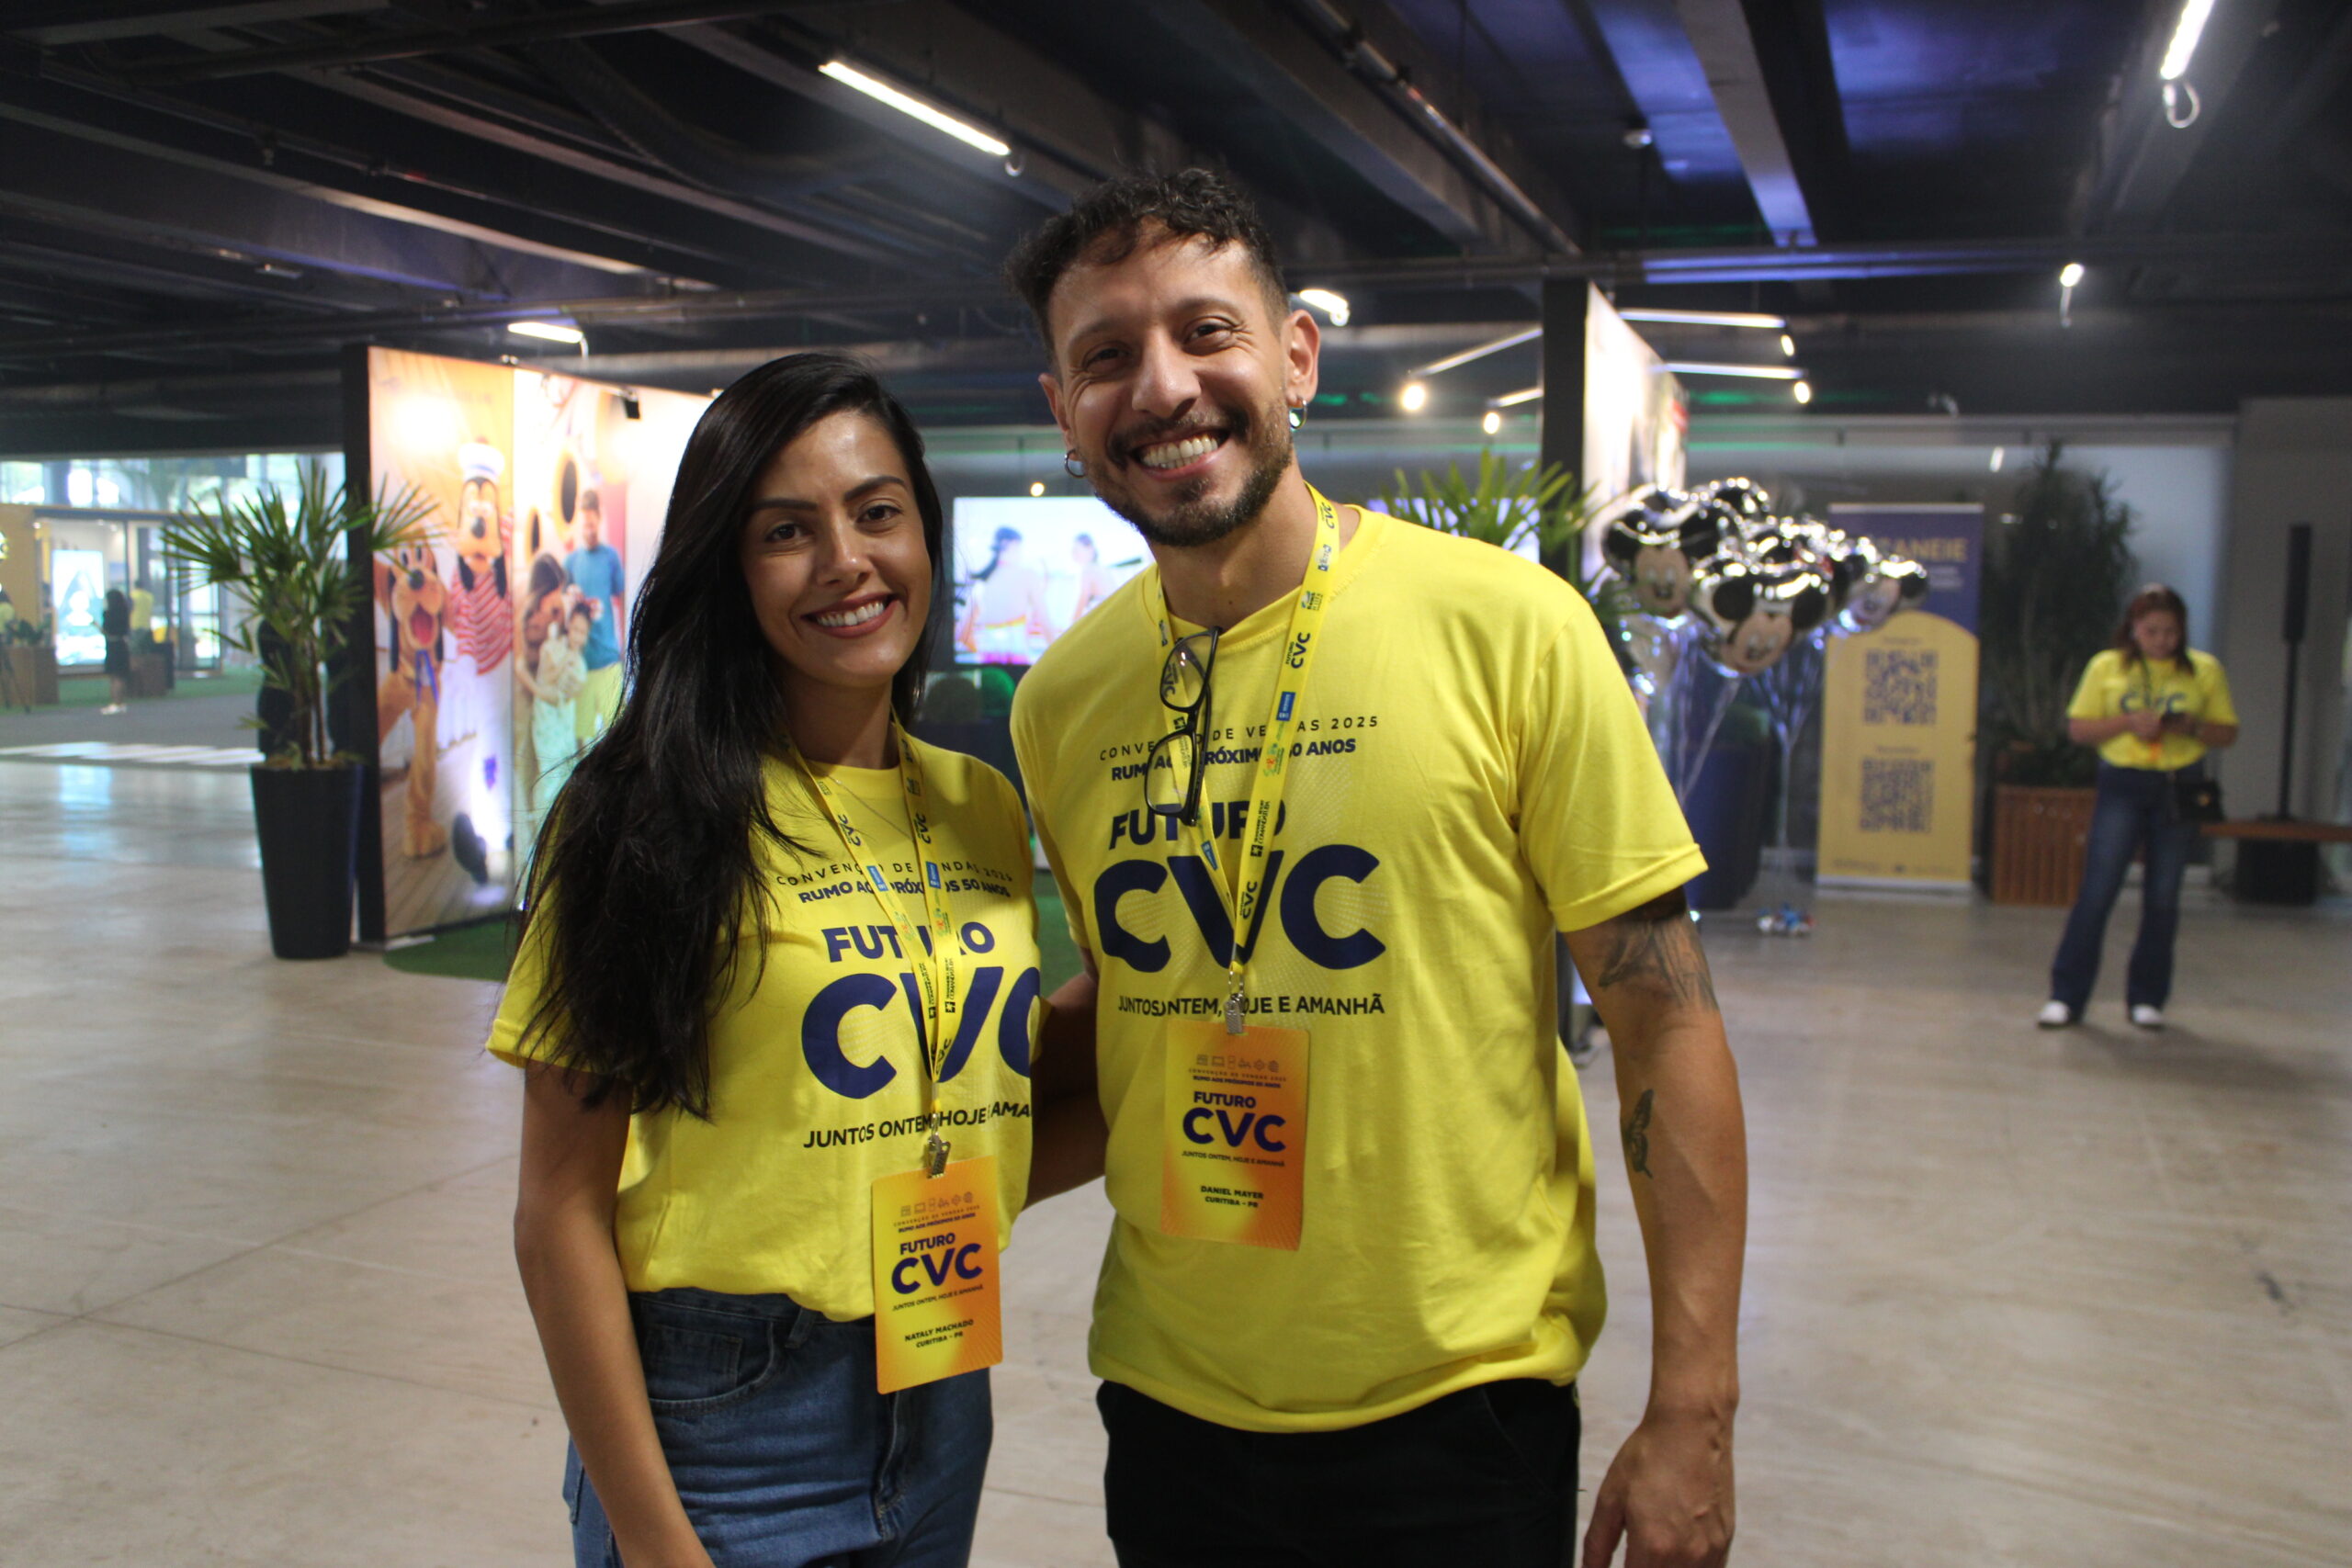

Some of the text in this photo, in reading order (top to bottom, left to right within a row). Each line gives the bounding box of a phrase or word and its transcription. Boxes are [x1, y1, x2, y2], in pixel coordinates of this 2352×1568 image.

[1291, 632, 1311, 669] CVC
[1213, 728, 1235, 741] DE
[1247, 719, 1320, 738] VEAS
[1331, 716, 1378, 729] 2025
[1112, 762, 1148, 781] RUM
[1204, 746, 1262, 764] RÓXIM
[1289, 742, 1303, 759] 0
[1306, 739, 1356, 756] ANOS
[837, 814, 862, 847] CVC
[892, 863, 913, 873] DE
[798, 881, 854, 903] RUMO
[961, 878, 980, 890] 50
[1243, 881, 1258, 919] CVC
[1093, 843, 1386, 973] CVC
[821, 921, 996, 963] FUTO
[1279, 996, 1291, 1012] E
[1295, 994, 1385, 1016] AMANHÃ
[1193, 1090, 1257, 1109] FUTURO
[803, 1123, 875, 1148] JUNTOS
[938, 1108, 986, 1127] HOJE
[990, 1101, 1031, 1118] AMA
[1182, 1107, 1286, 1152] CVC
[1182, 1150, 1207, 1159] JUNTOS
[1200, 1185, 1264, 1200] DANIEL MAYER
[1204, 1195, 1240, 1206] CURITIBA
[899, 1232, 956, 1256] FUTURO
[891, 1243, 984, 1295] CVC
[892, 1301, 915, 1312] JUNTOS
[904, 1318, 975, 1342] NATALY MACHADO
[916, 1335, 948, 1348] CURITIBA
